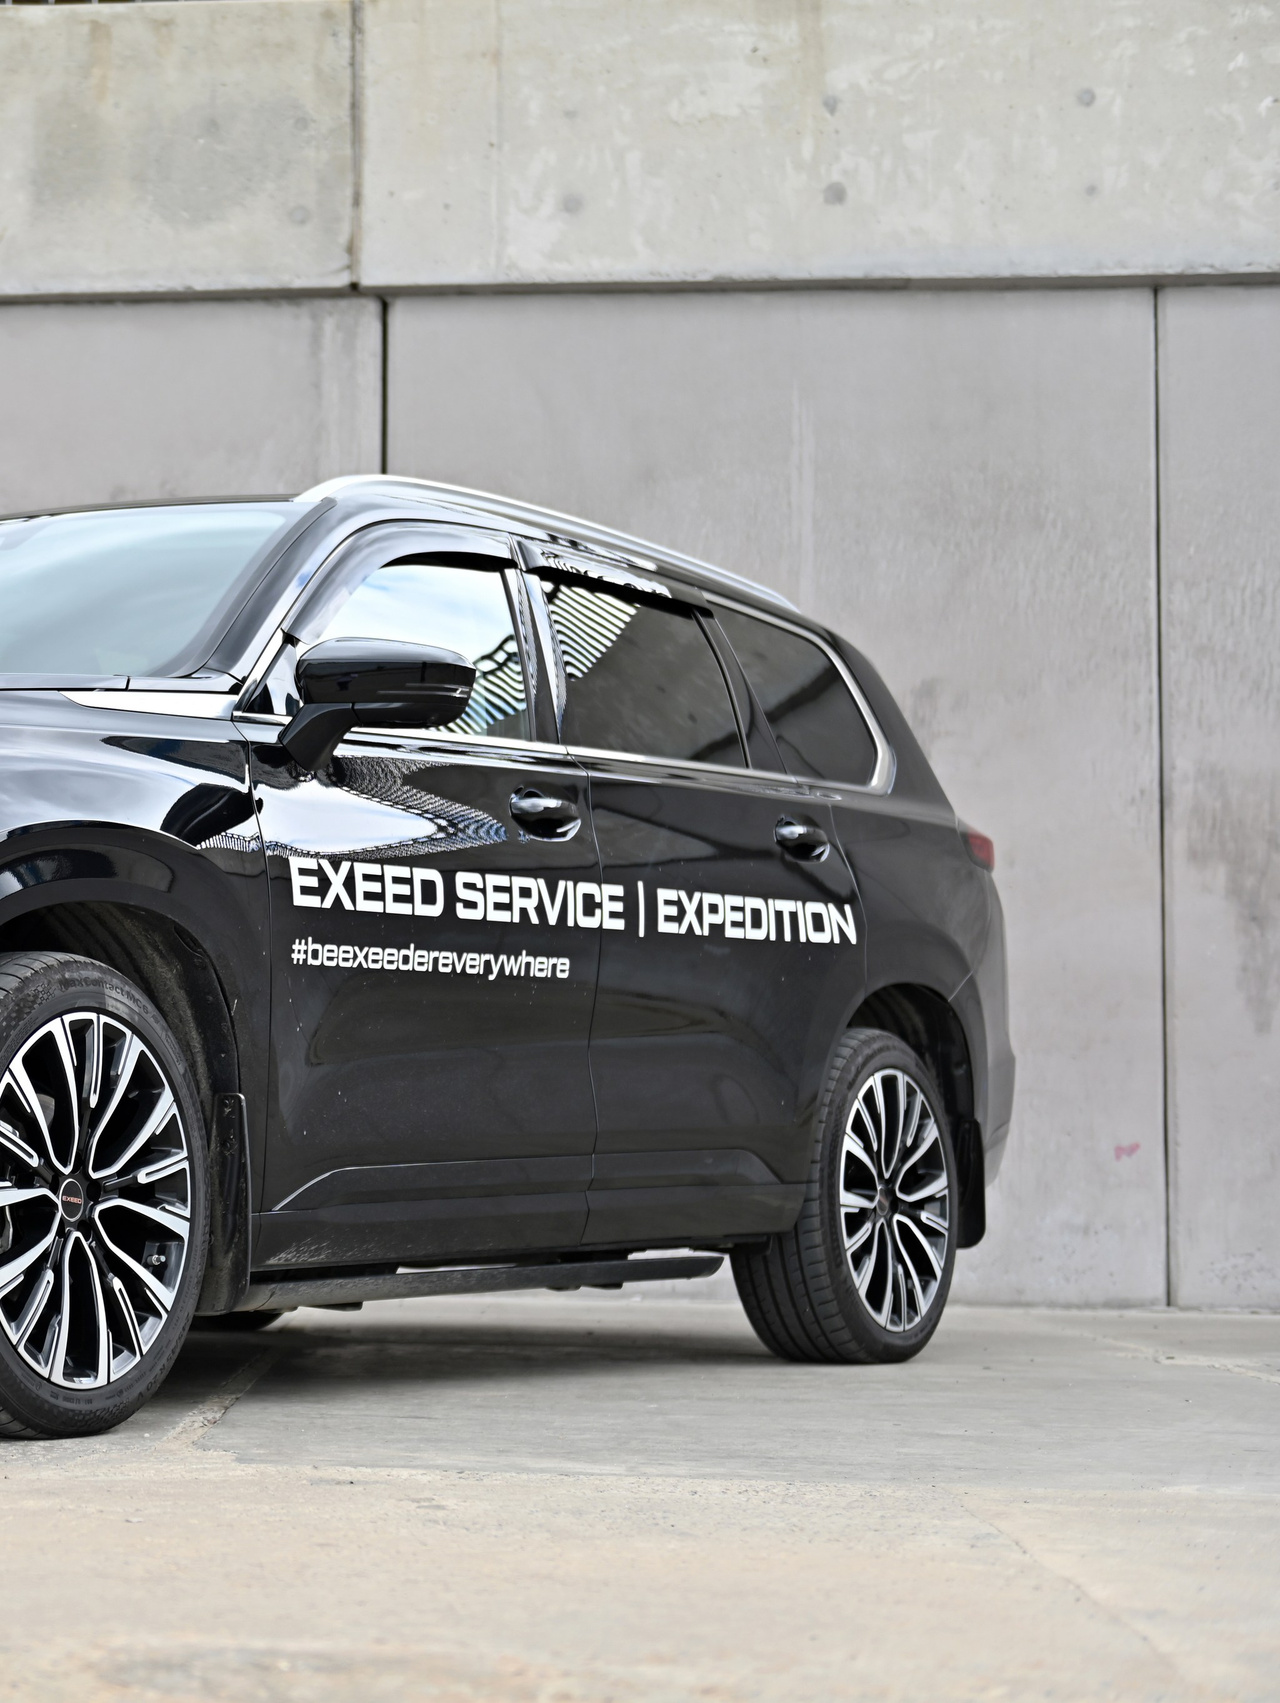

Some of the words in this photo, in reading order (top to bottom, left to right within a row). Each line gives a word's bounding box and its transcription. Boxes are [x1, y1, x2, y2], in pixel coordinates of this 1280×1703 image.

[288, 856, 445, 917] EXEED
[455, 871, 625, 930] SERVICE
[657, 888, 857, 945] EXPEDITION
[291, 936, 570, 981] #beexeedereverywhere
